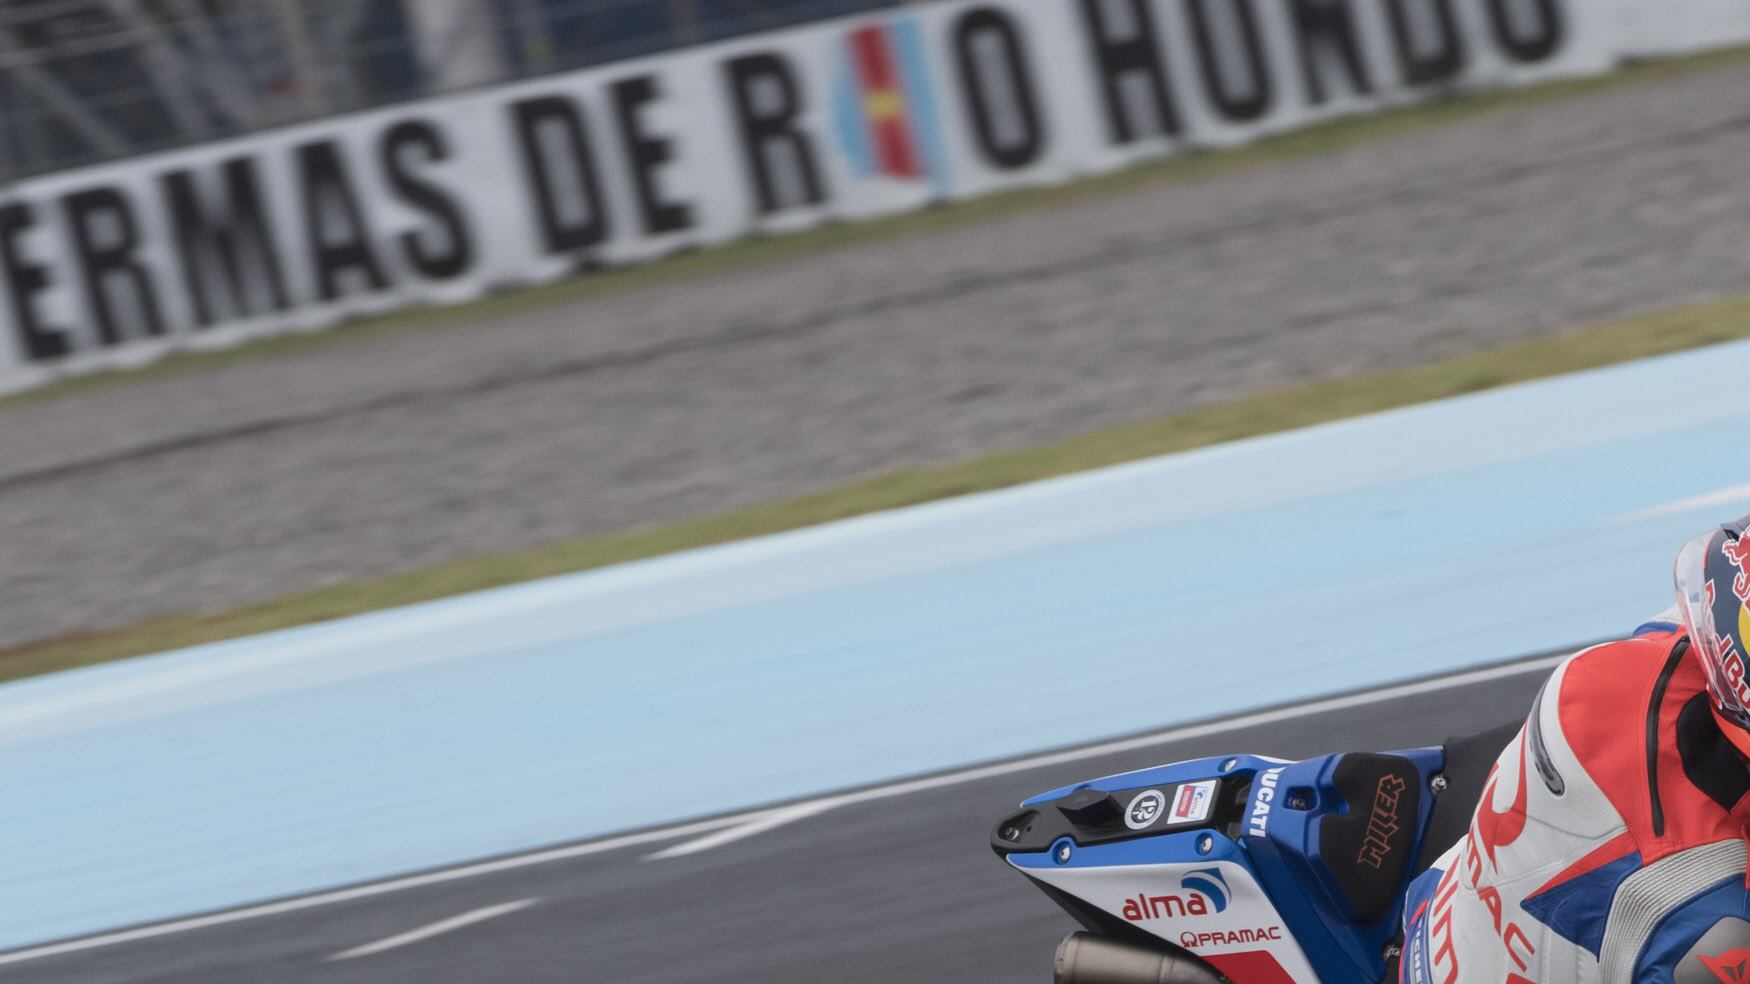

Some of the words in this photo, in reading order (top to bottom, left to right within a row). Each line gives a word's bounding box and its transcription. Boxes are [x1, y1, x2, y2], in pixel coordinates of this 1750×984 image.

[507, 74, 699, 255] DE
[1356, 773, 1406, 869] MILLER
[1122, 893, 1208, 921] alma
[1199, 926, 1282, 947] PRAMAC
